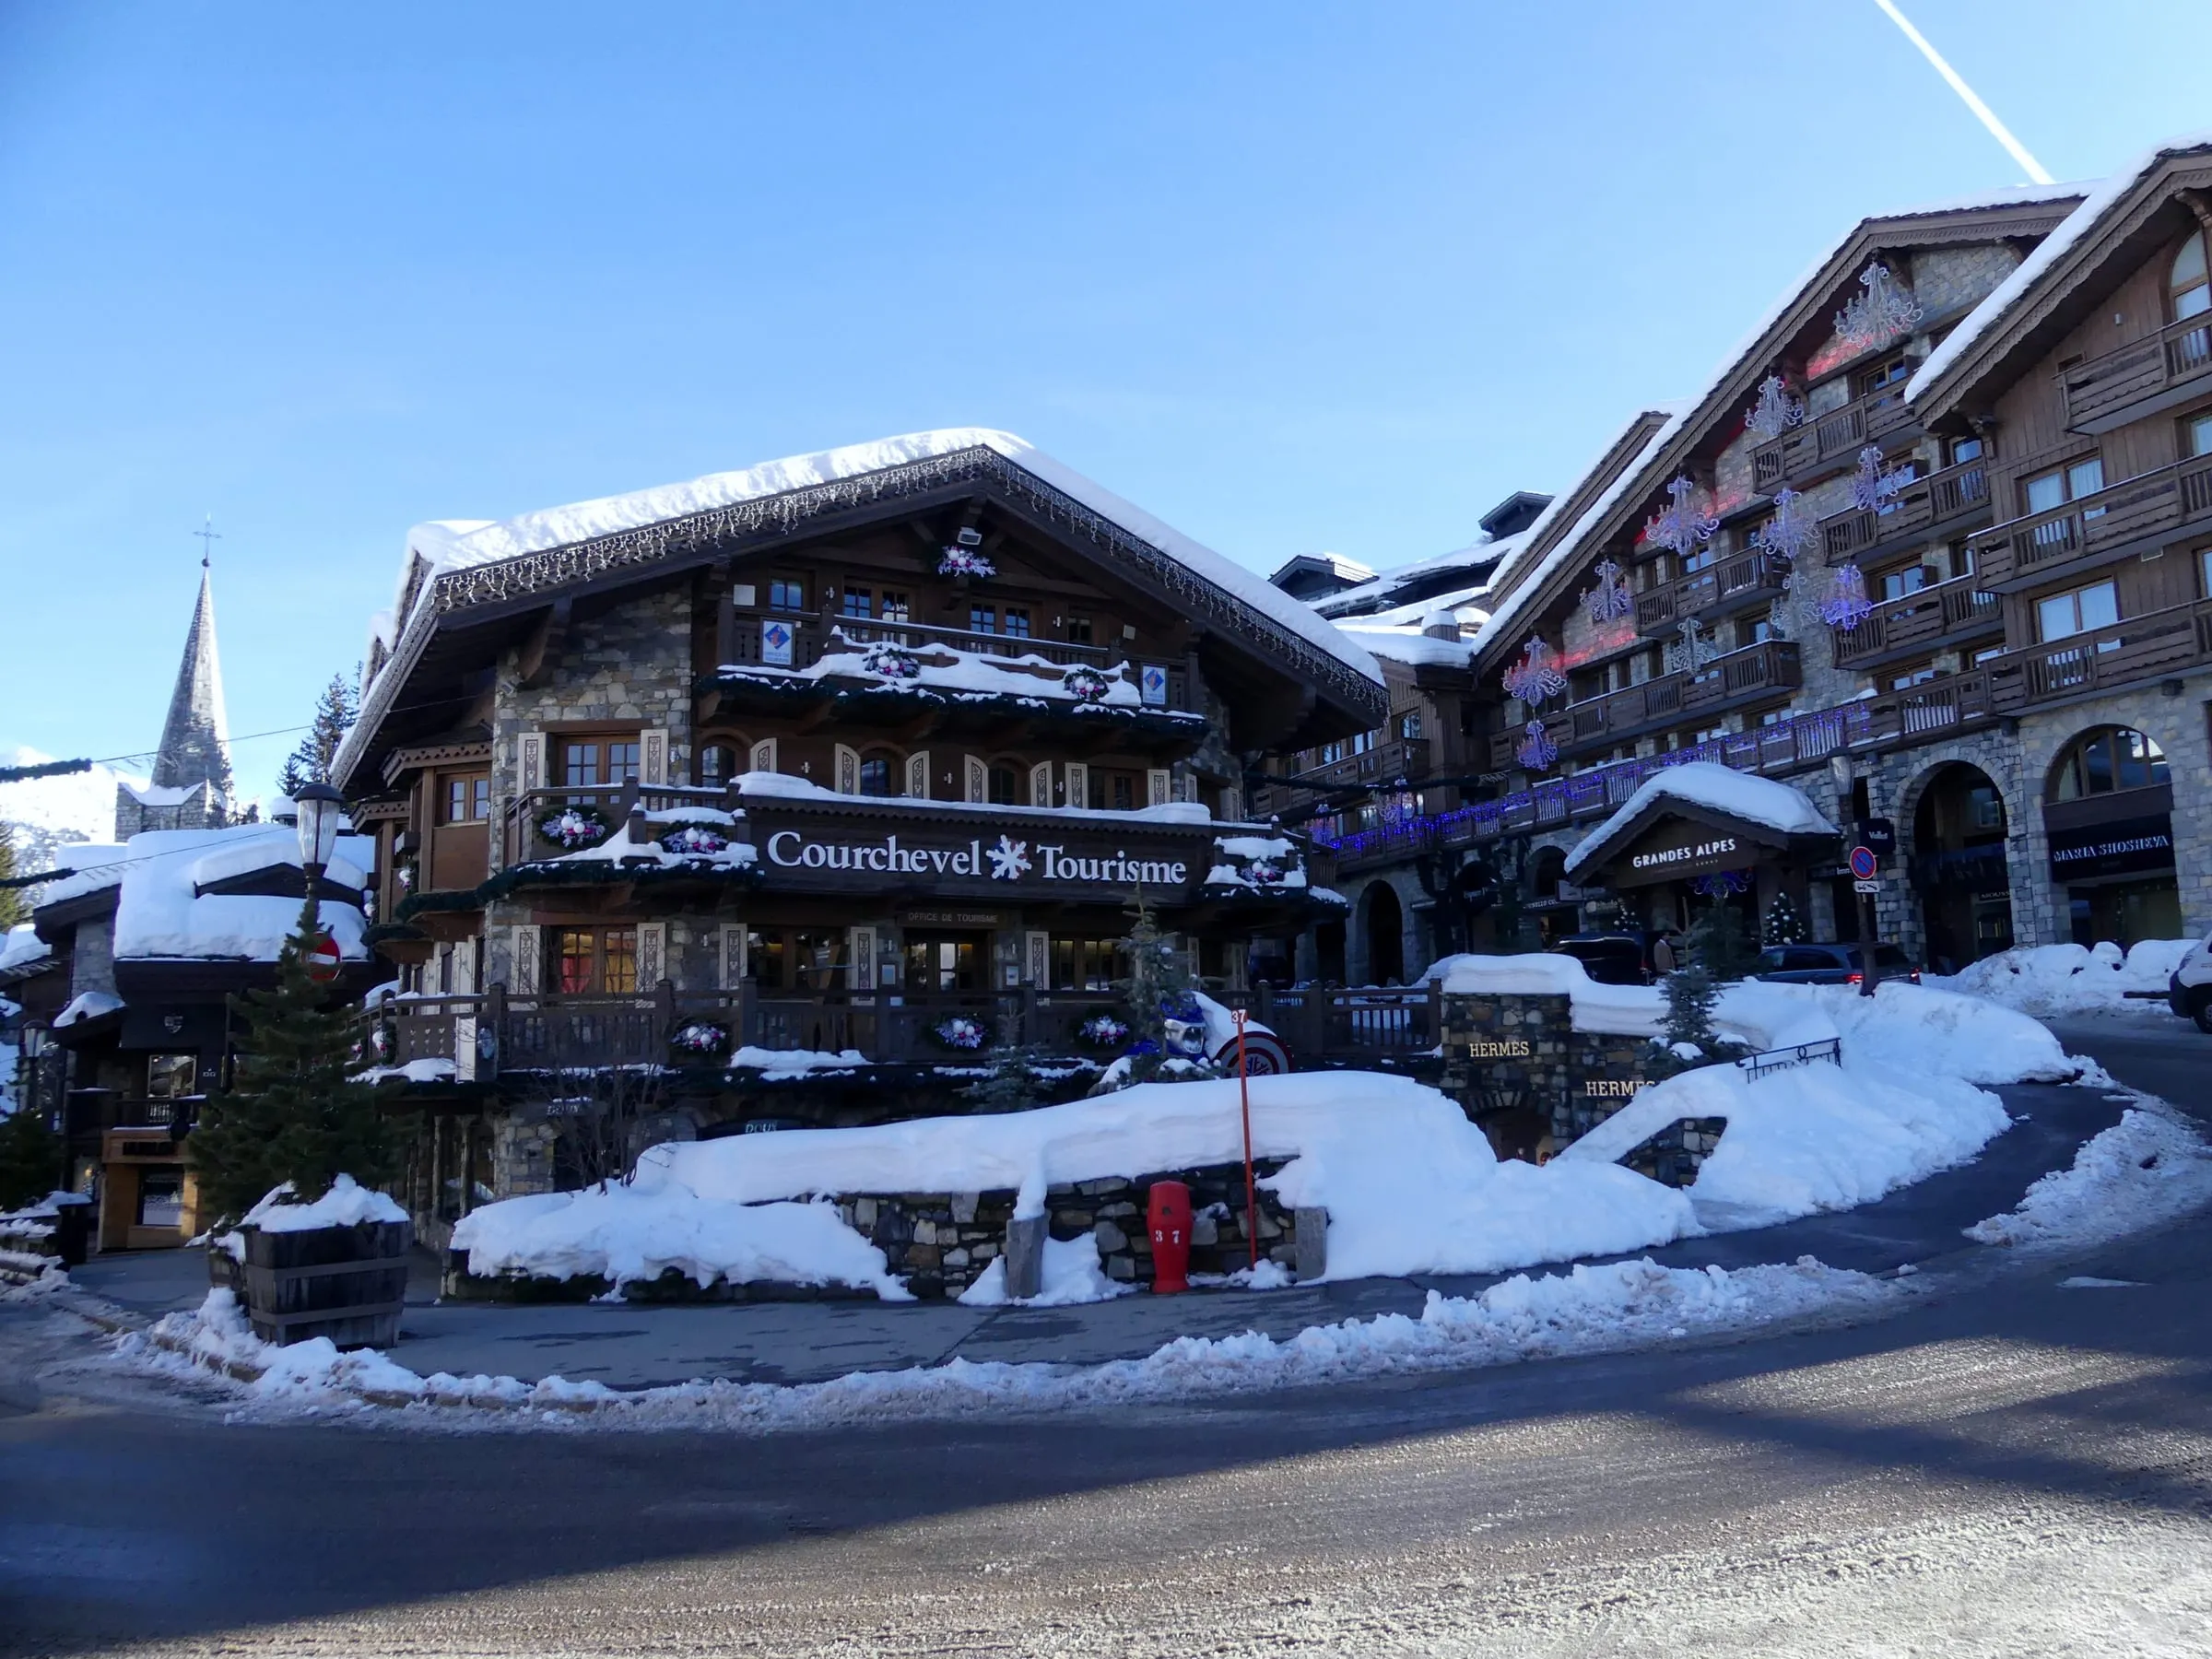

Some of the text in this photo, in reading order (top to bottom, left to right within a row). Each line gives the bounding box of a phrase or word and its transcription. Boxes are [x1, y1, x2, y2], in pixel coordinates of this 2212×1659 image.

[768, 831, 1186, 884] Courchevel Tourisme
[1632, 839, 1735, 868] GRANDES ALPES
[2053, 845, 2097, 862] MARIA
[908, 912, 998, 924] OFFICE DE TOURISME
[1231, 1009, 1247, 1024] 37
